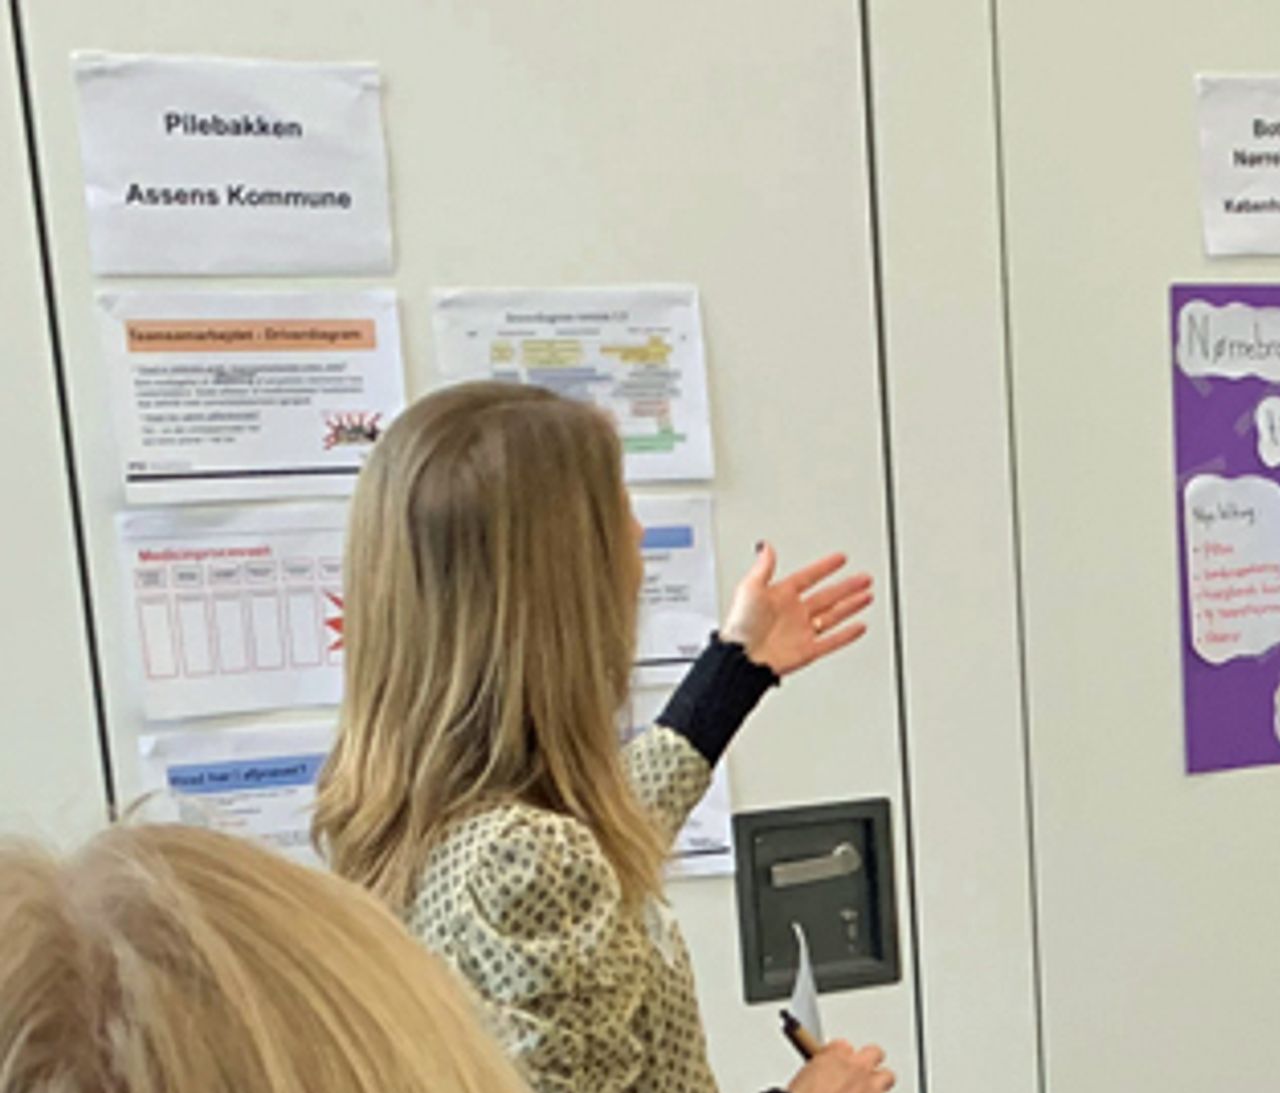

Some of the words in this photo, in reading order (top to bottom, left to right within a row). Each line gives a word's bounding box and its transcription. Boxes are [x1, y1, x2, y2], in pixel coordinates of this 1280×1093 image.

[164, 112, 303, 137] Pilebakken
[125, 183, 221, 205] Assens
[226, 185, 352, 208] Kommune
